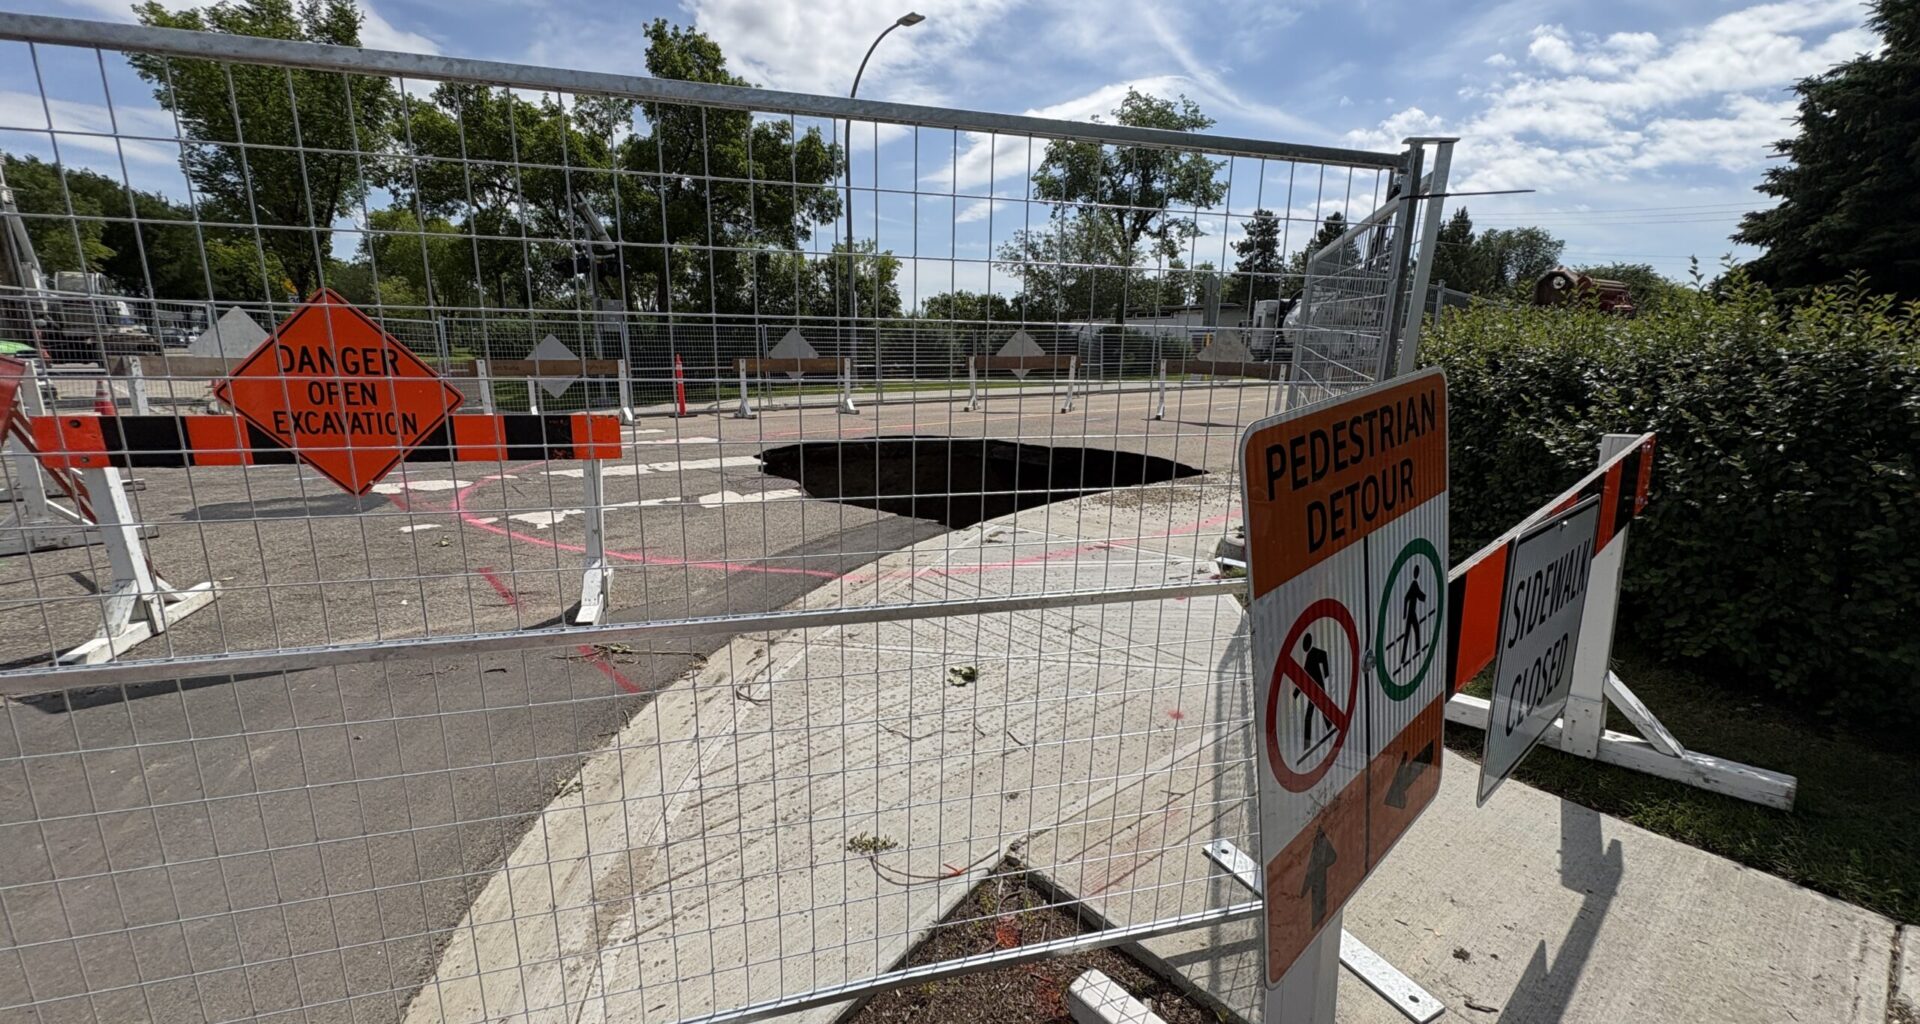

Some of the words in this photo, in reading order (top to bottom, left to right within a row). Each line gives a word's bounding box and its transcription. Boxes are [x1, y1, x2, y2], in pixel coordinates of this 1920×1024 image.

[275, 345, 400, 376] DANGER
[308, 381, 378, 406] OPEN
[273, 410, 418, 435] EXCAVATION
[1266, 389, 1436, 501] PEDESTRIAN
[1307, 458, 1414, 554] DETOUR
[1508, 538, 1591, 649] SIDEWALK
[1506, 632, 1568, 737] CLOSED
